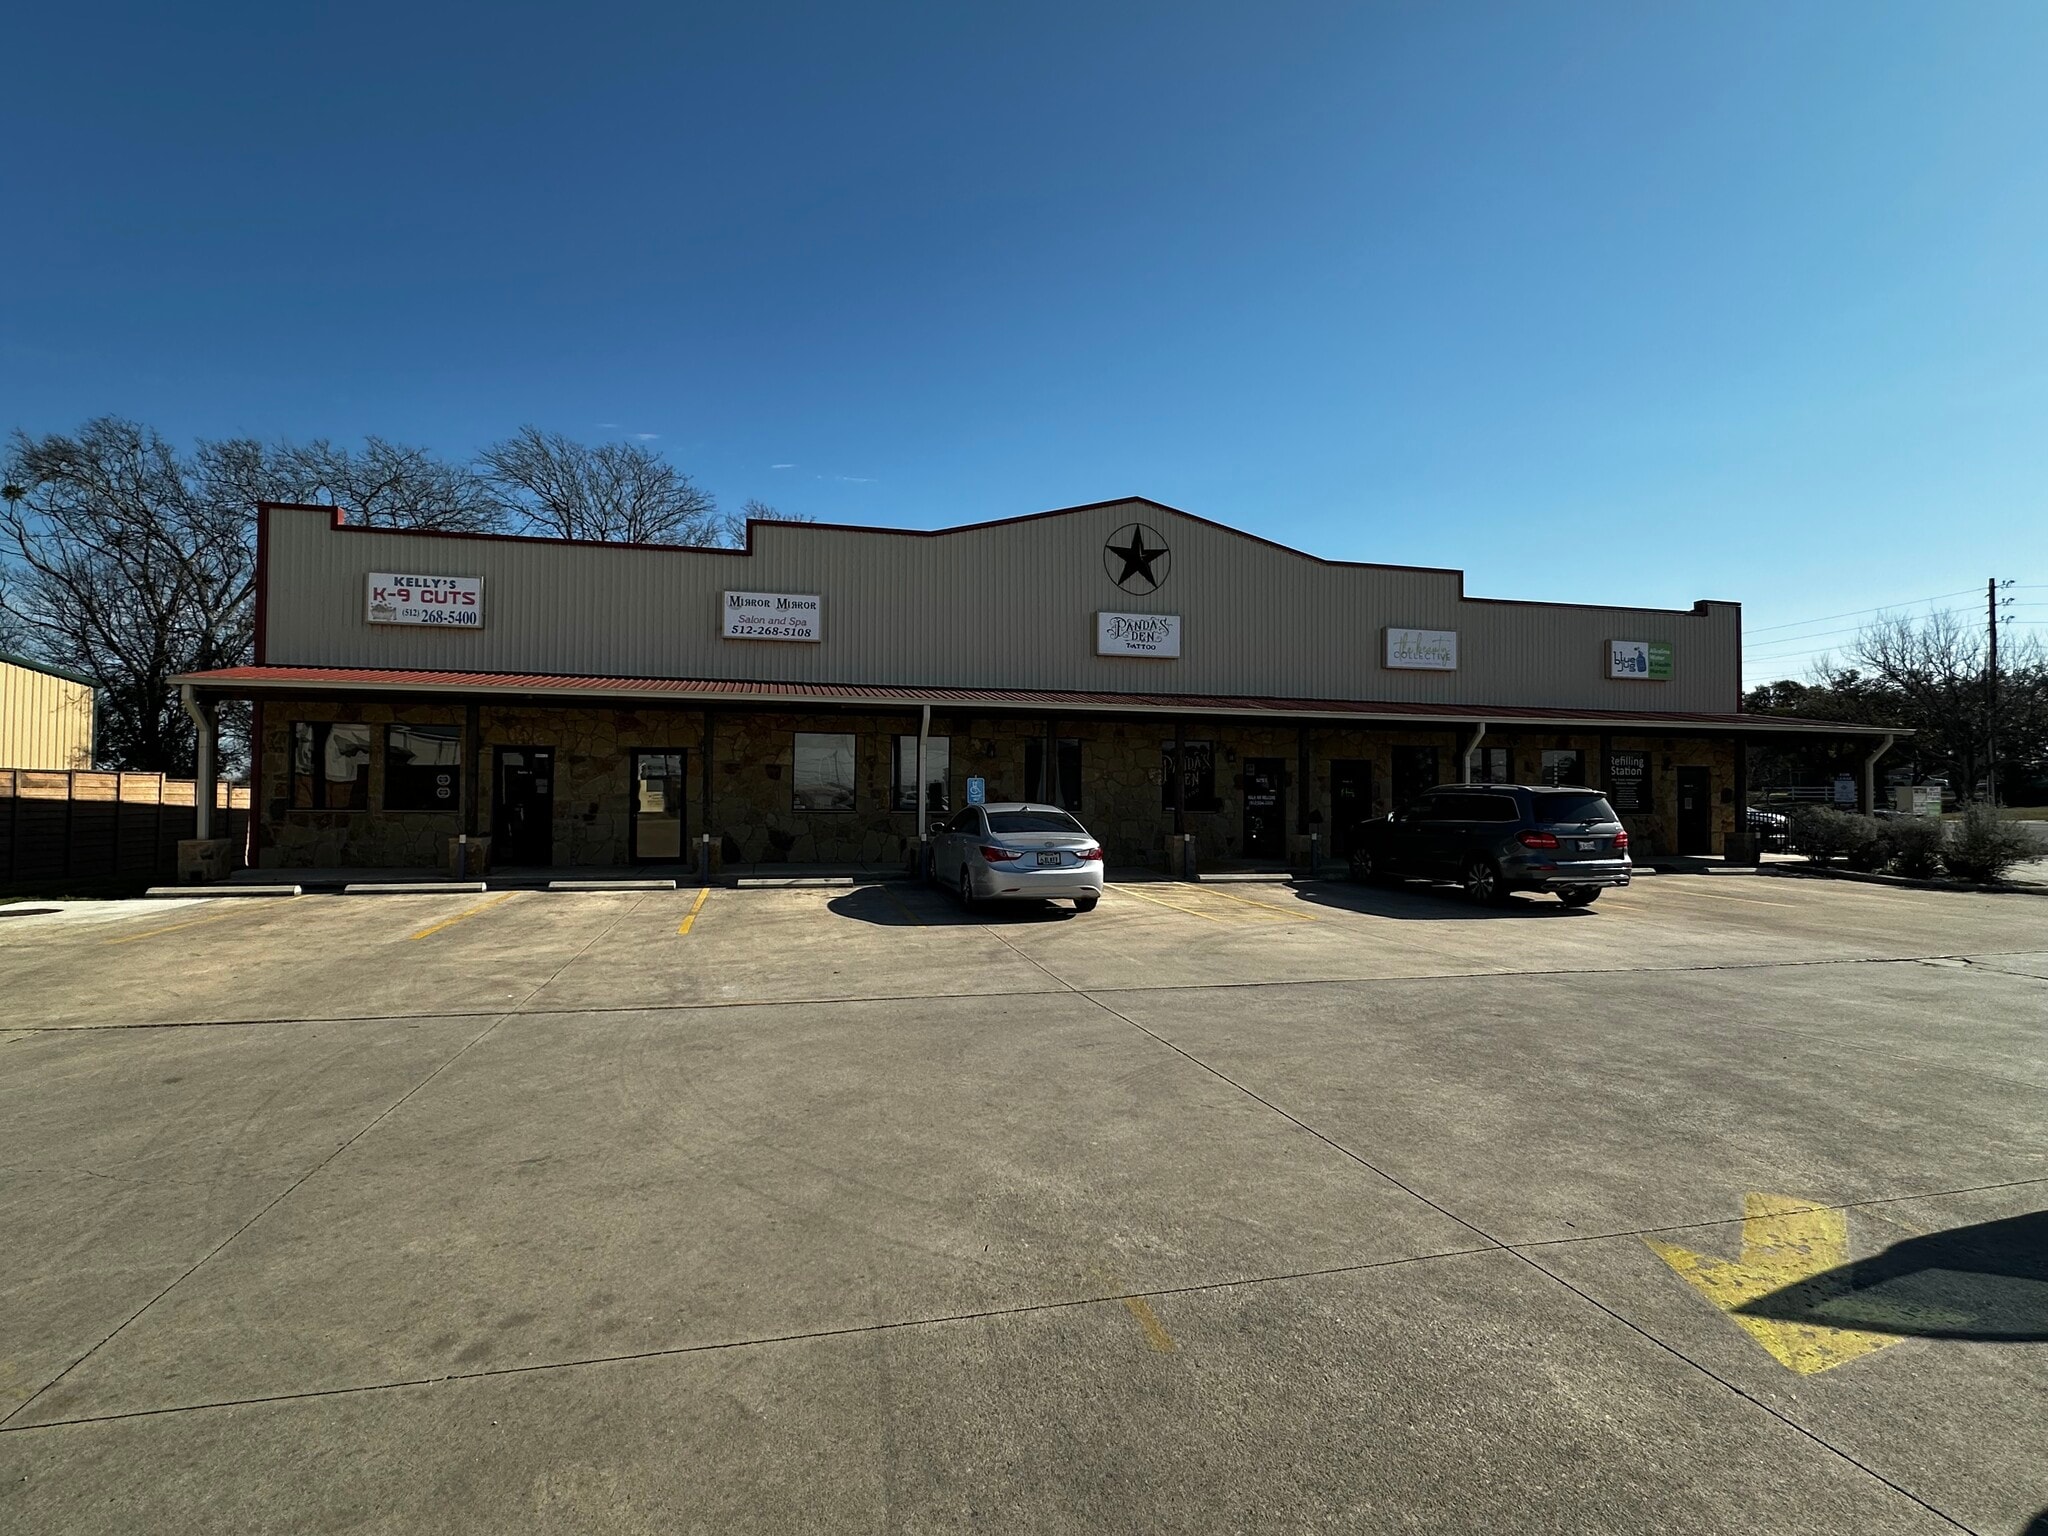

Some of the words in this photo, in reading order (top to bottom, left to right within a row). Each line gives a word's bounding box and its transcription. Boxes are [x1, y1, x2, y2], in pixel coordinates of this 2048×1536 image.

[394, 577, 456, 589] KELLY'S
[373, 587, 411, 602] K-9
[421, 590, 476, 606] CUTS
[402, 608, 420, 617] (512)
[421, 609, 477, 625] 268-5400
[738, 614, 765, 624] Salon
[768, 616, 787, 625] and
[789, 617, 807, 627] Spa
[731, 625, 812, 637] 512-268-5108
[1107, 617, 1172, 640] PANDA'S
[1131, 631, 1155, 642] DEN
[1126, 642, 1157, 651] TATTOO
[1394, 651, 1451, 662] COLLECTIVE
[1613, 651, 1636, 665] blue
[1617, 661, 1636, 672] jug
[1611, 766, 1642, 776] Station
